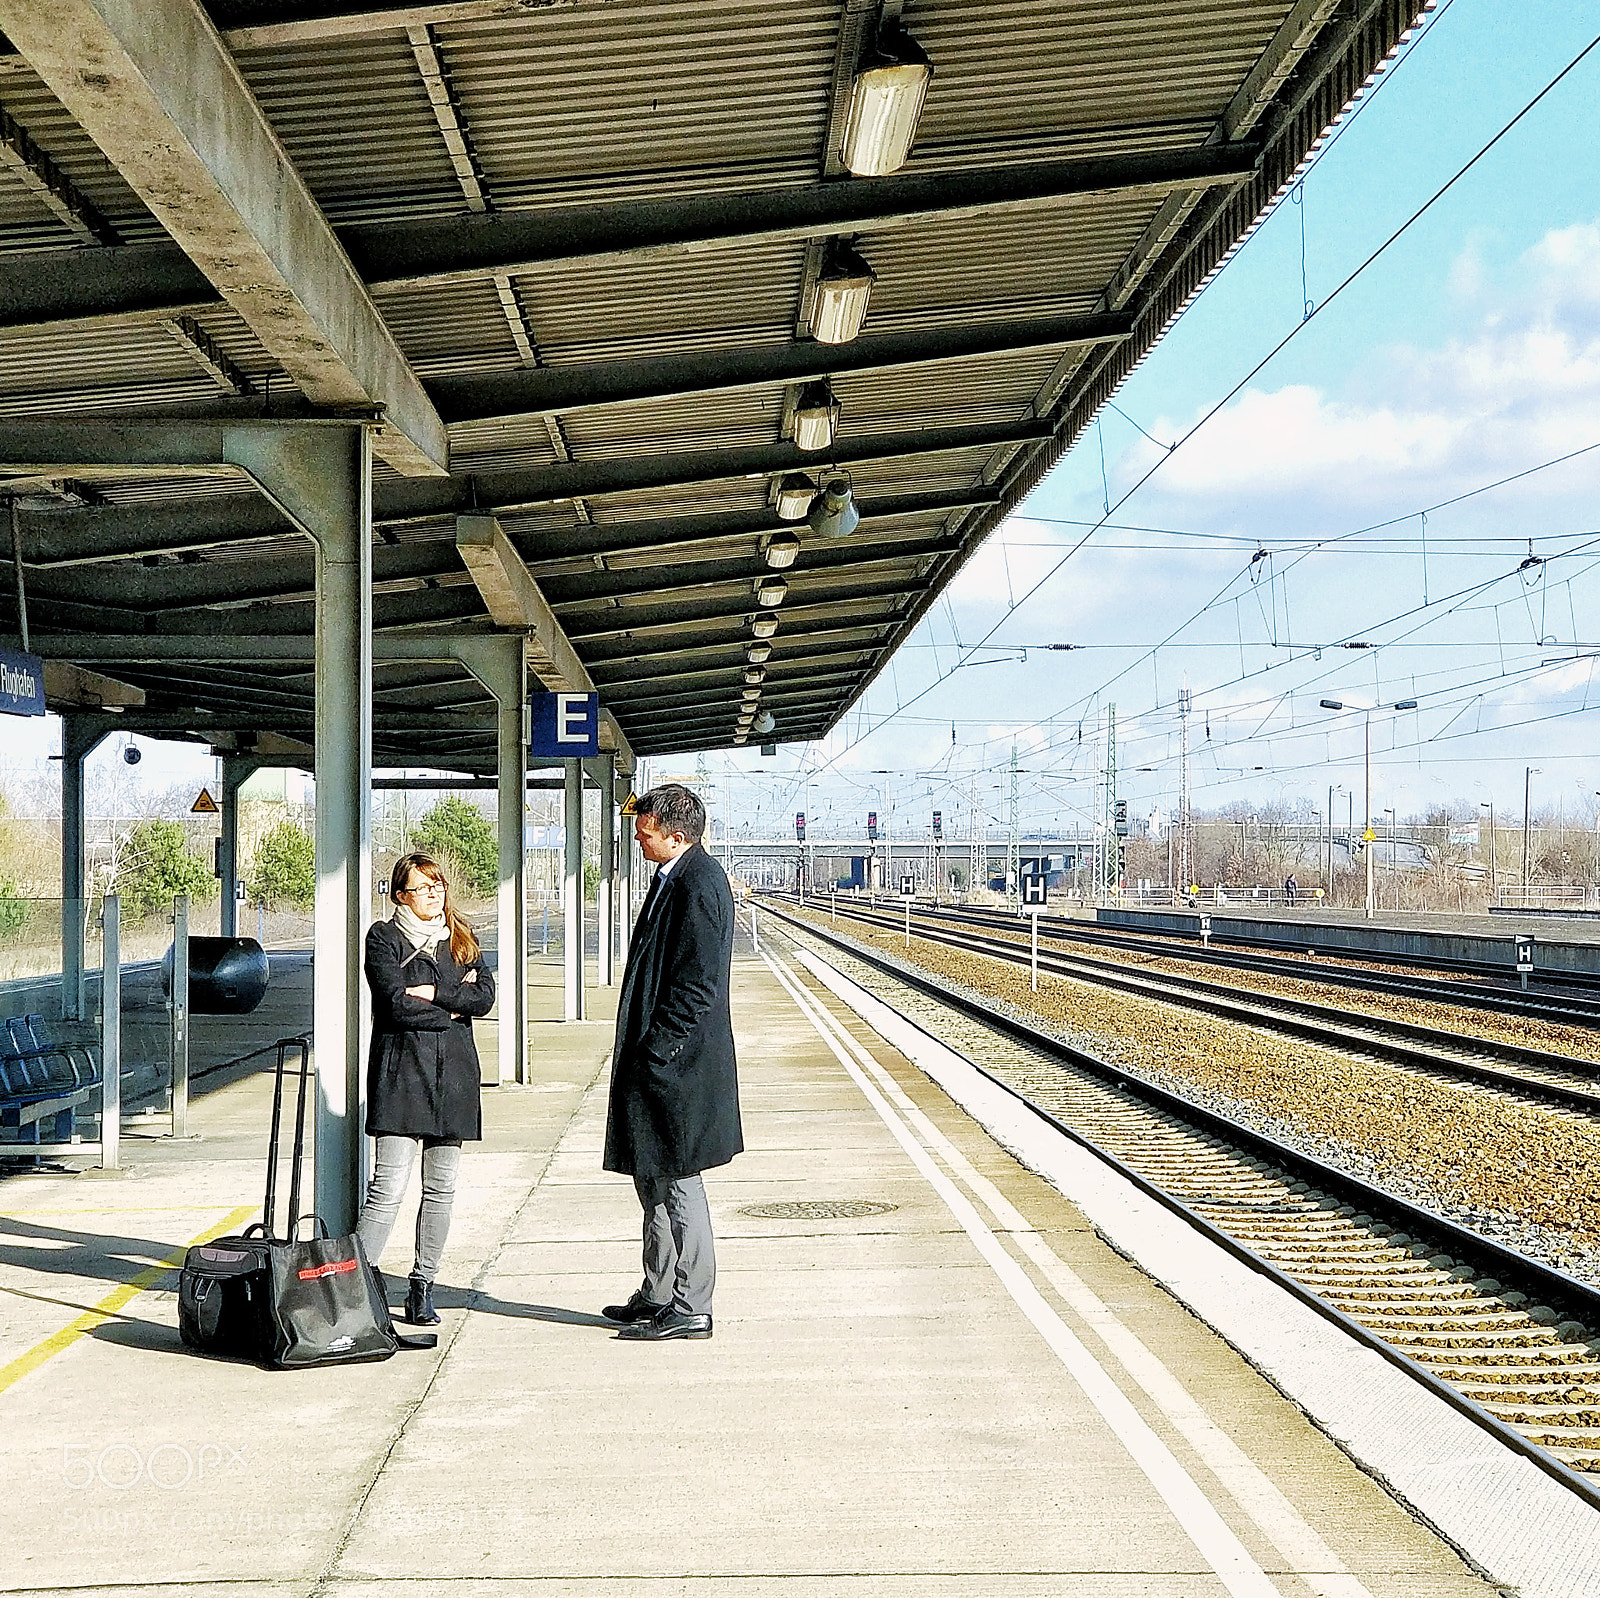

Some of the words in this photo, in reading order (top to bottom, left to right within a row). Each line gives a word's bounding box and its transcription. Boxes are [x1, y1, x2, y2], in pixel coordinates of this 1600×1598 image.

[1, 663, 35, 702] Flughafen
[557, 693, 589, 742] E
[533, 827, 546, 845] F
[379, 881, 388, 892] H
[829, 881, 838, 892] H
[901, 877, 914, 893] H
[1026, 876, 1044, 902] H
[1201, 918, 1211, 929] H
[1519, 945, 1531, 962] H
